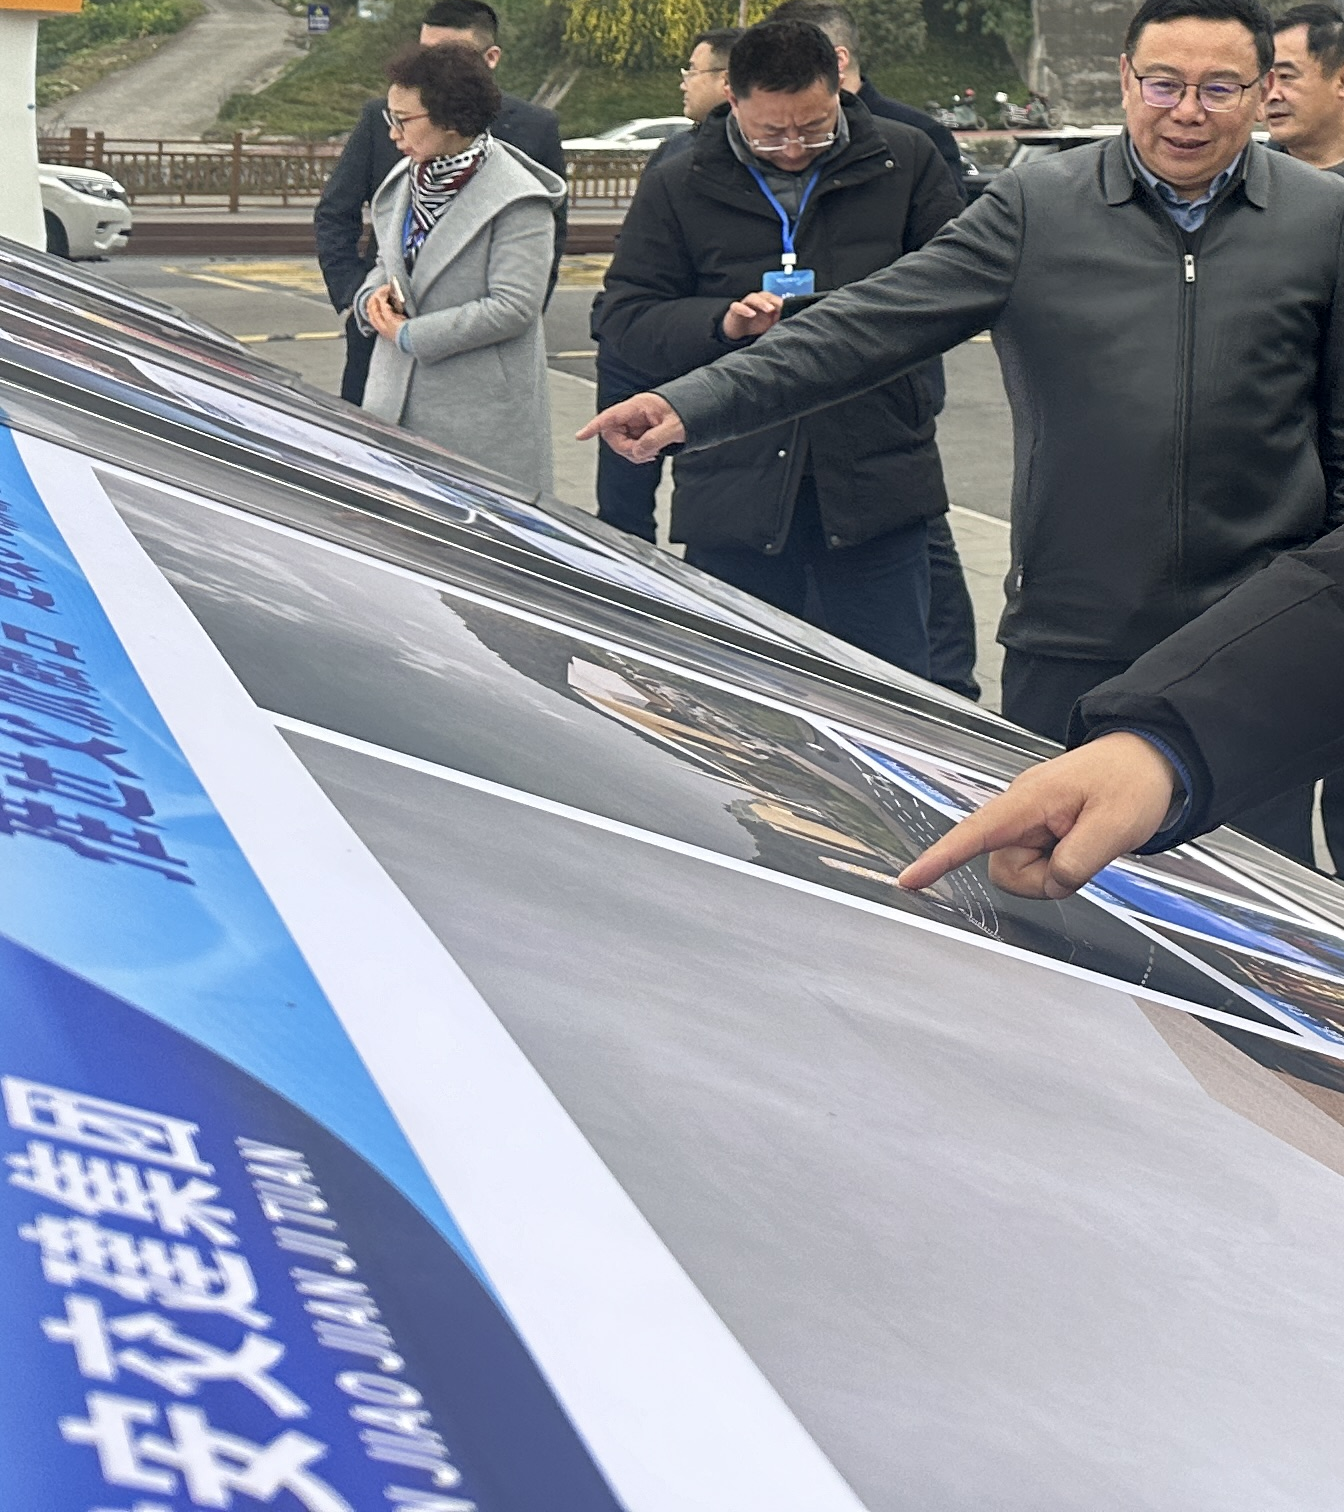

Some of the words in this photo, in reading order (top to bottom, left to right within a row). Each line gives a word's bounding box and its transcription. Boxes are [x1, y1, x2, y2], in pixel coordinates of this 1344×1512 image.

[234, 1135, 338, 1232] TUAN
[2, 1074, 356, 1512] 安交建集团
[289, 1265, 407, 1374] JIAN
[334, 1370, 463, 1489] JIAO
